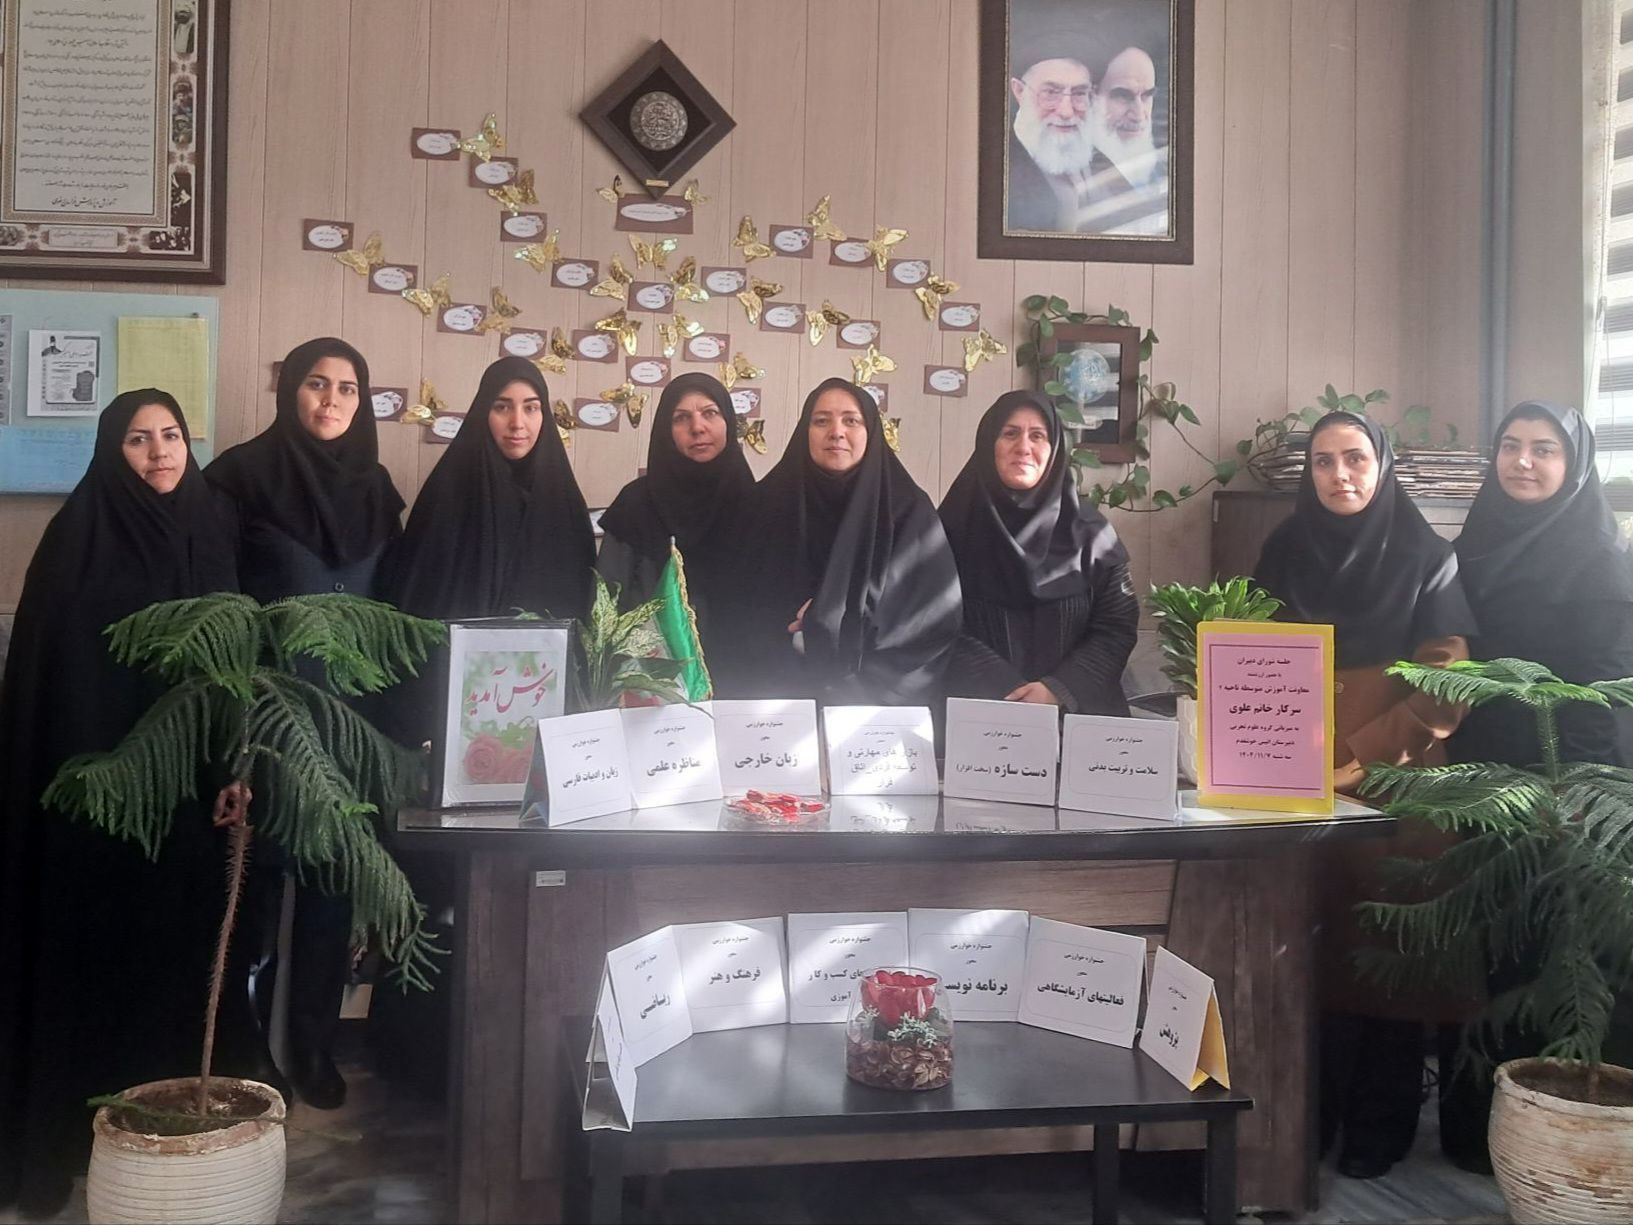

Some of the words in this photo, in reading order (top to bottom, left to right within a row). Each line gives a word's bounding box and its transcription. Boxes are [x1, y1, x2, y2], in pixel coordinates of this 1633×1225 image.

[1237, 657, 1256, 665] دبیران
[1257, 658, 1275, 666] شورای
[464, 666, 508, 716] آمدید
[496, 661, 553, 714] خوش
[1241, 684, 1263, 693] متوسطه
[1288, 686, 1309, 694] معاونت
[1229, 703, 1251, 714] علوی
[1254, 704, 1273, 714] خانم
[735, 752, 772, 768] خارجی
[776, 752, 797, 767] زبان
[606, 767, 619, 780] زبان
[646, 760, 670, 776] علمی
[994, 764, 1019, 778] سازه
[1021, 767, 1047, 778] دست
[1088, 764, 1107, 772] بدنی
[1108, 764, 1129, 775] تربیت
[1129, 768, 1134, 776] و
[1135, 766, 1158, 775] سلامت
[563, 772, 581, 788] فارسی
[583, 769, 601, 782] ادبیات
[709, 972, 723, 984] هنر
[726, 974, 730, 983] و
[732, 966, 760, 982] فرهنگ
[808, 970, 822, 981] کار
[830, 969, 848, 978] کسب
[944, 978, 972, 995] نویس
[976, 979, 1008, 996] برنامه
[1037, 982, 1086, 1000] آزمایشگاهی
[1087, 992, 1124, 1006] فعالیتهای
[640, 993, 671, 1020] ریاضی
